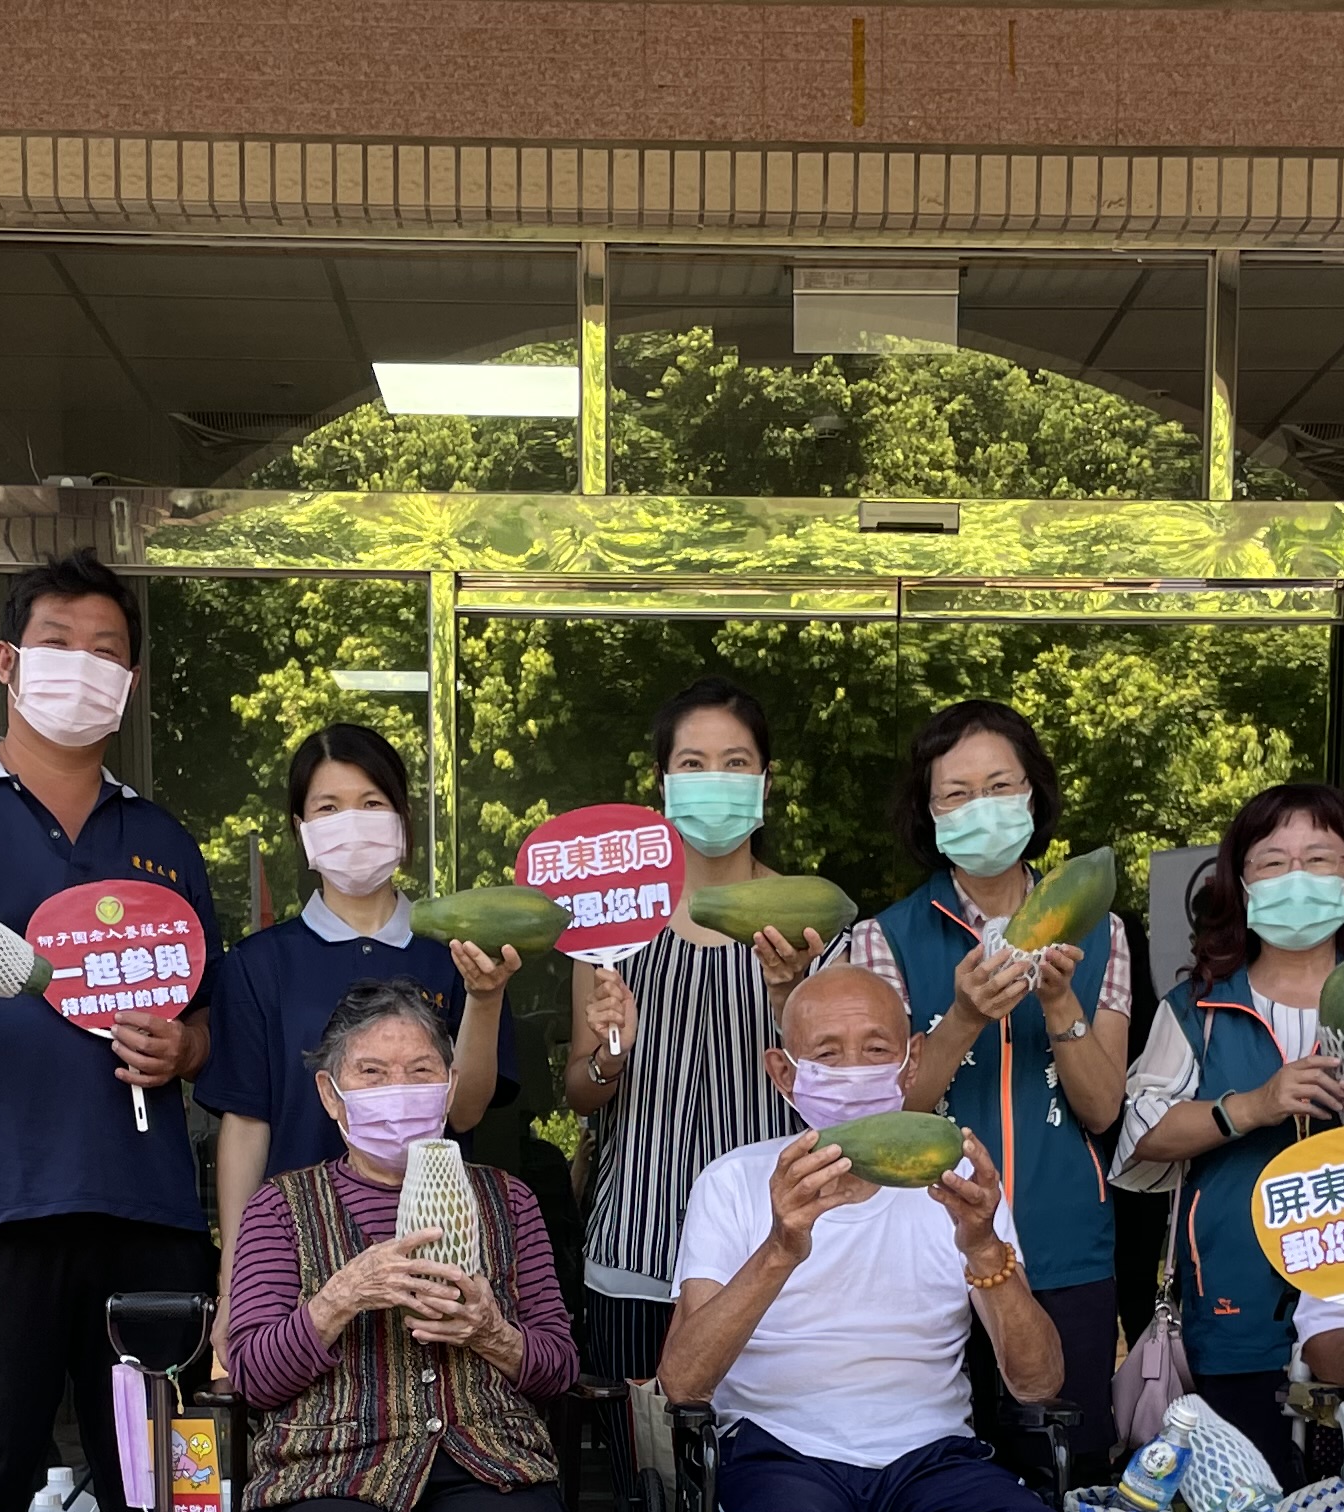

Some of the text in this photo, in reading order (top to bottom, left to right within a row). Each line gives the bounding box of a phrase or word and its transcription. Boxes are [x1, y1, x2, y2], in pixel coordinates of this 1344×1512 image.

[527, 824, 672, 886] 屏東郵局
[37, 919, 191, 949] 椰子園老人養護之家
[52, 943, 192, 988] 一起參與
